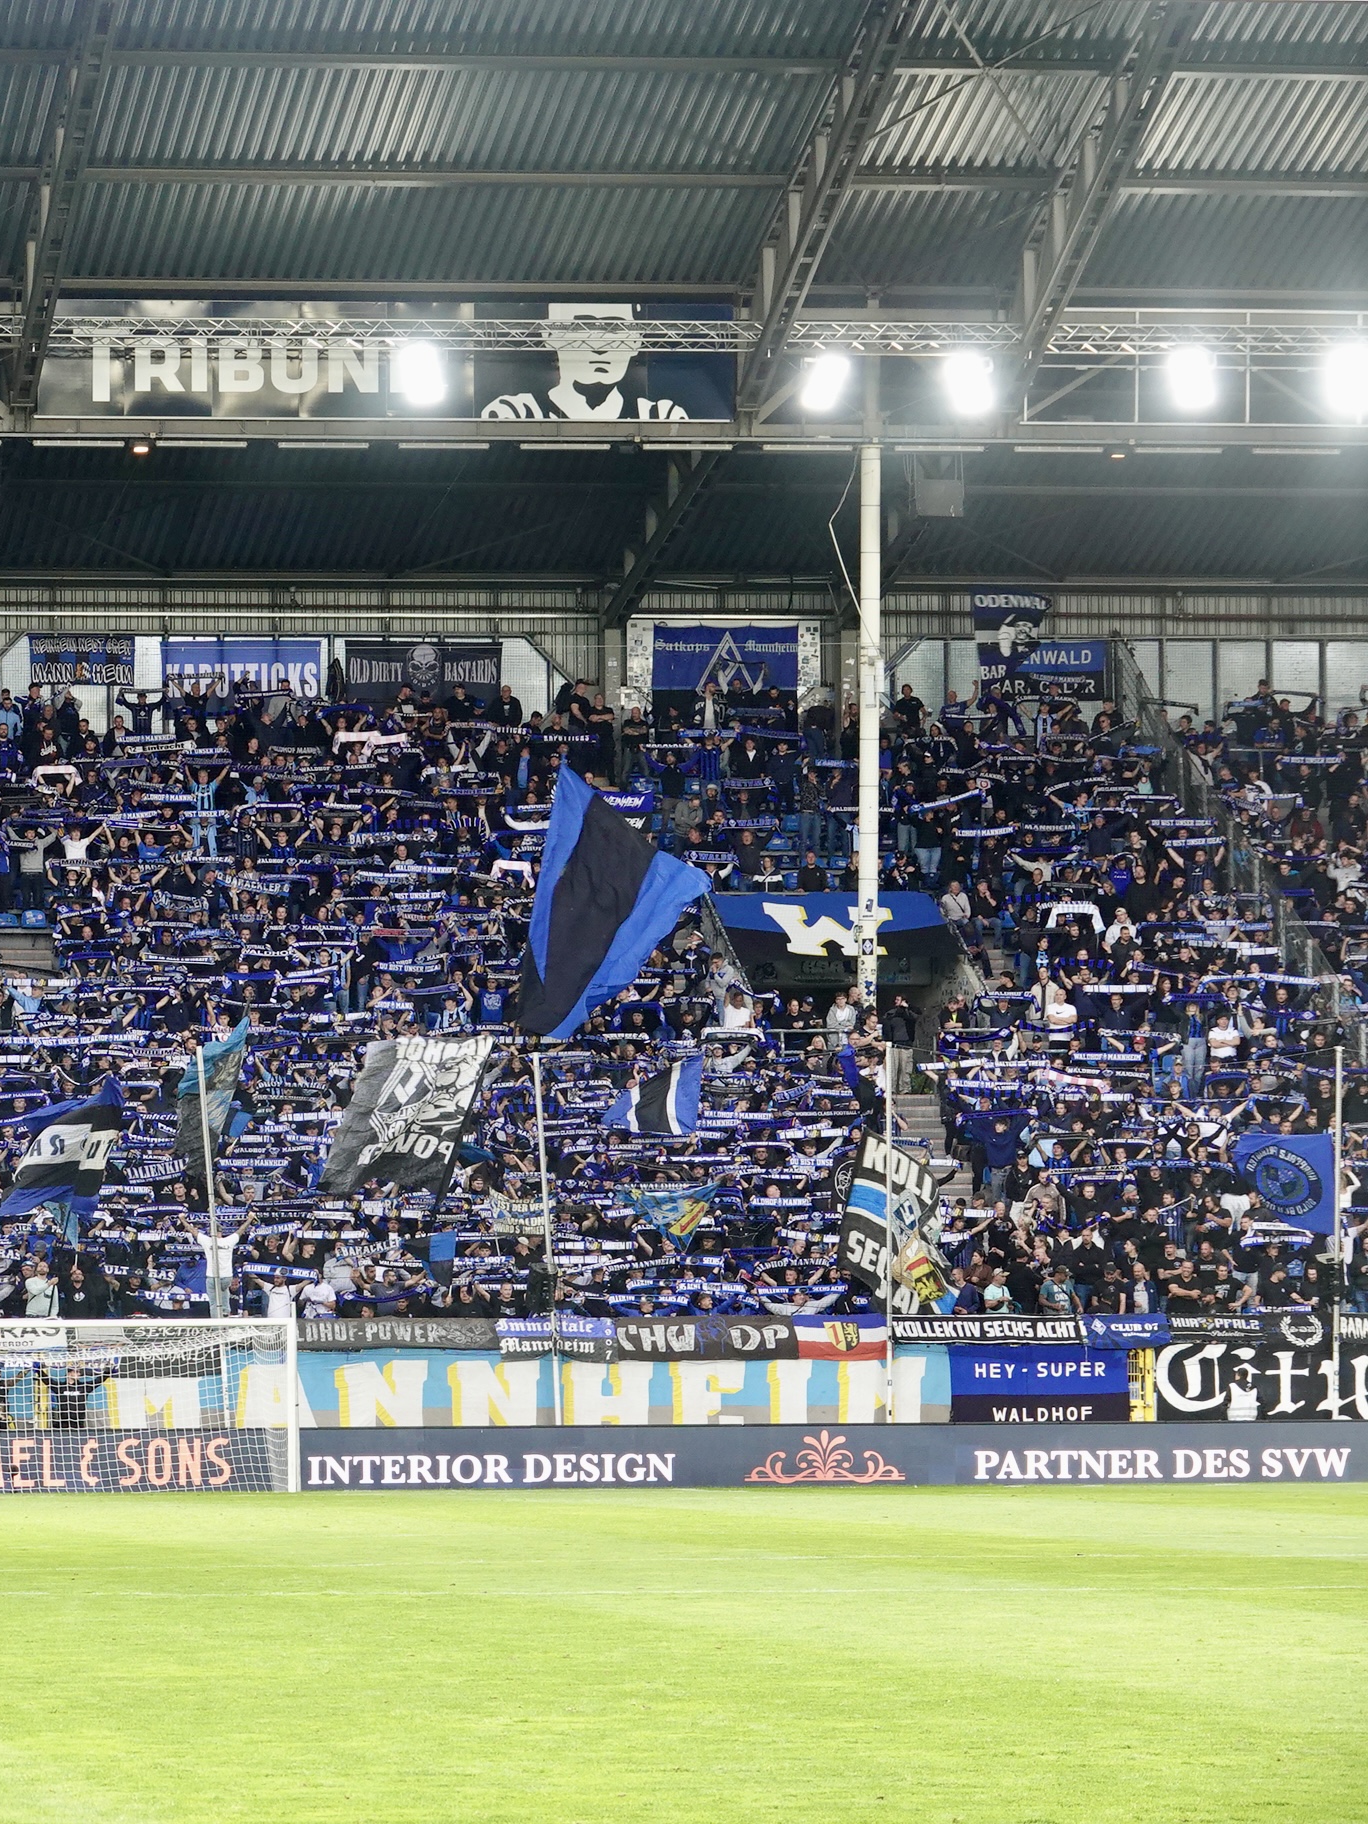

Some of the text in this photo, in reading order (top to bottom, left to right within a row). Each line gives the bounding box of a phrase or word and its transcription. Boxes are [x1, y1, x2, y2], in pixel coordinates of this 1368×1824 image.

[744, 640, 798, 654] Mannheim
[349, 657, 497, 684] OLD DIRTY BASTARDS
[981, 664, 1007, 680] BAR
[165, 662, 318, 700] KAPUTTICKS
[403, 964, 424, 973] UNSER
[1074, 1052, 1142, 1061] WALDHOF MANNHEIM
[220, 1158, 289, 1168] WALDHOF MANNHEIM
[103, 1264, 175, 1281] ULT RAS
[144, 1290, 170, 1300] ULT
[892, 1318, 1076, 1338] KOLLEKTIV SECHS ACHT
[1110, 1322, 1159, 1332] CLUB 07
[974, 1362, 1016, 1379] HEY
[1036, 1361, 1106, 1378] SUPER
[992, 1405, 1093, 1422] WALDHOF
[118, 1437, 232, 1486] SONS
[308, 1453, 676, 1485] INTERIOR DESIGN
[973, 1447, 1352, 1480] PARTNER DES SVW
